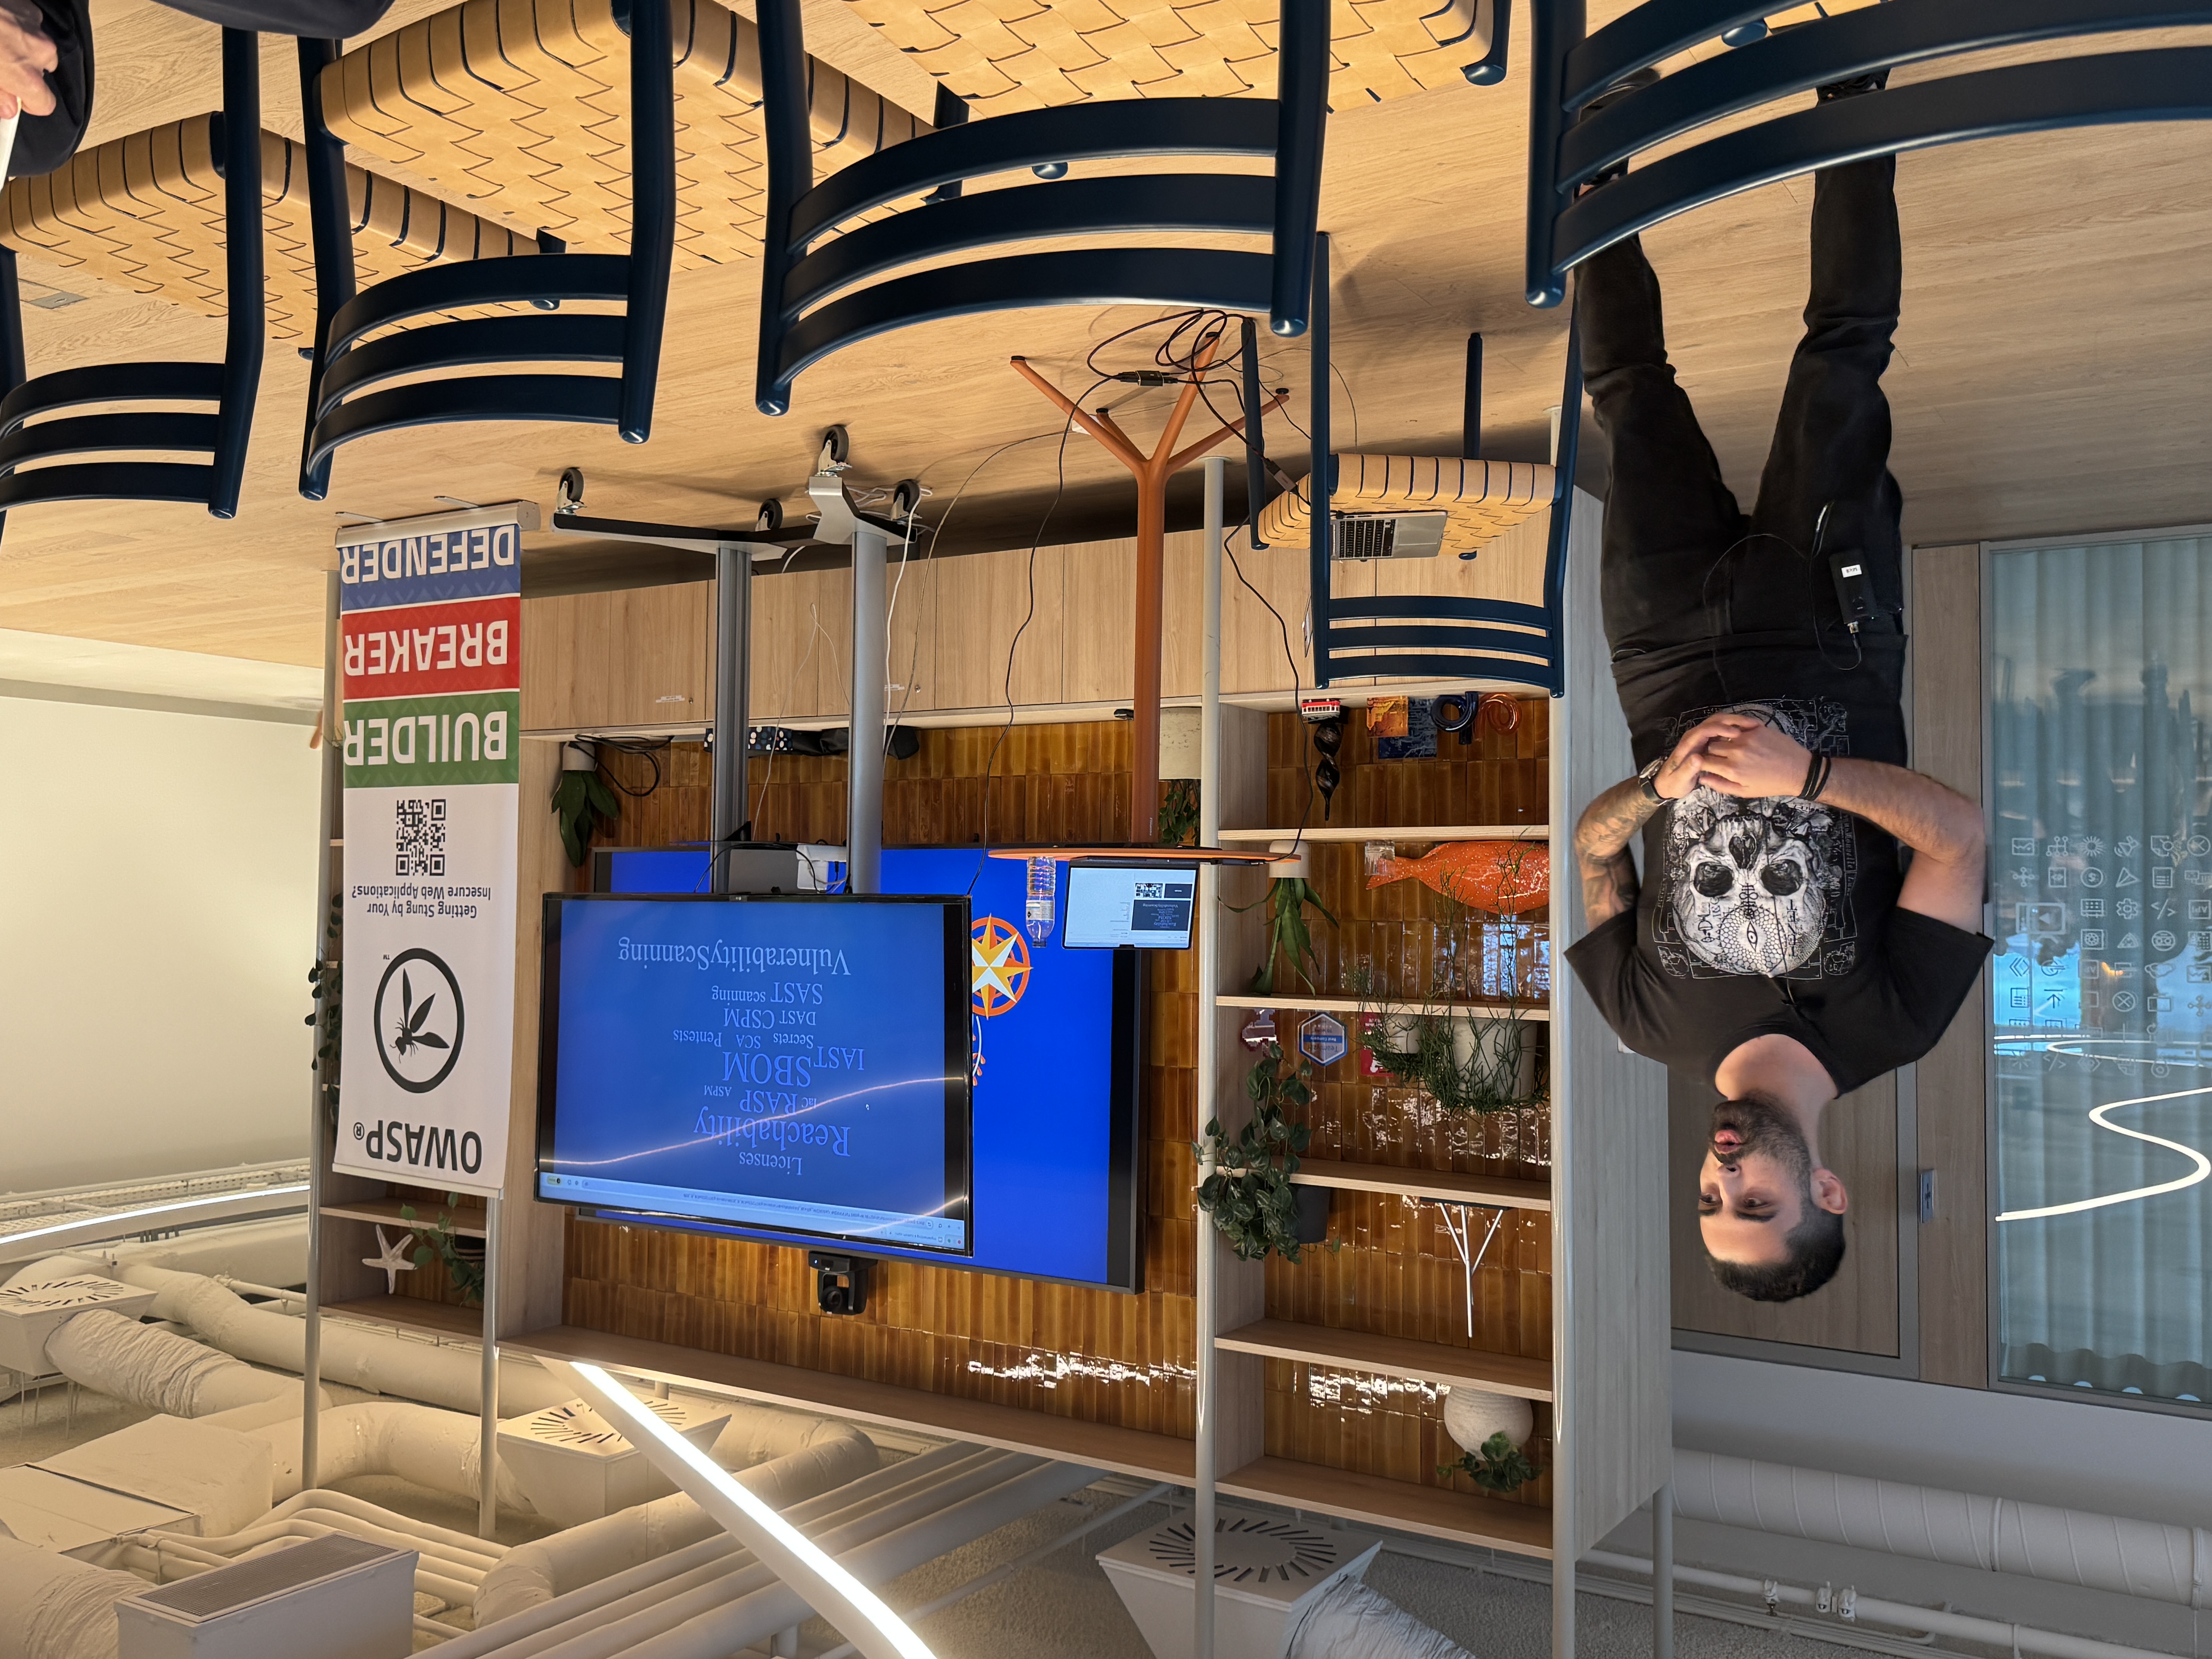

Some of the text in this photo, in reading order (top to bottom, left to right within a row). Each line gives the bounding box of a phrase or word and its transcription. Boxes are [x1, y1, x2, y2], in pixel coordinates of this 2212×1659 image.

[341, 525, 515, 584] DEFENDER
[345, 619, 508, 676] BREAKER
[344, 711, 507, 766] BUILDER
[352, 883, 491, 900] Insecure Web Applications?
[367, 901, 477, 919] Getting Stung by Your
[618, 937, 851, 975] VulnerabilityScanning
[711, 982, 823, 1005] SAST scanning
[723, 1008, 816, 1029] DAST CSPM
[673, 1030, 814, 1049] Secrets SCA Pentests
[722, 1046, 864, 1087] IAST SBOM
[704, 1085, 732, 1097] ASPM
[740, 1089, 797, 1116] RASP
[694, 1106, 851, 1157] Reachability
[739, 1151, 802, 1175] Licenses
